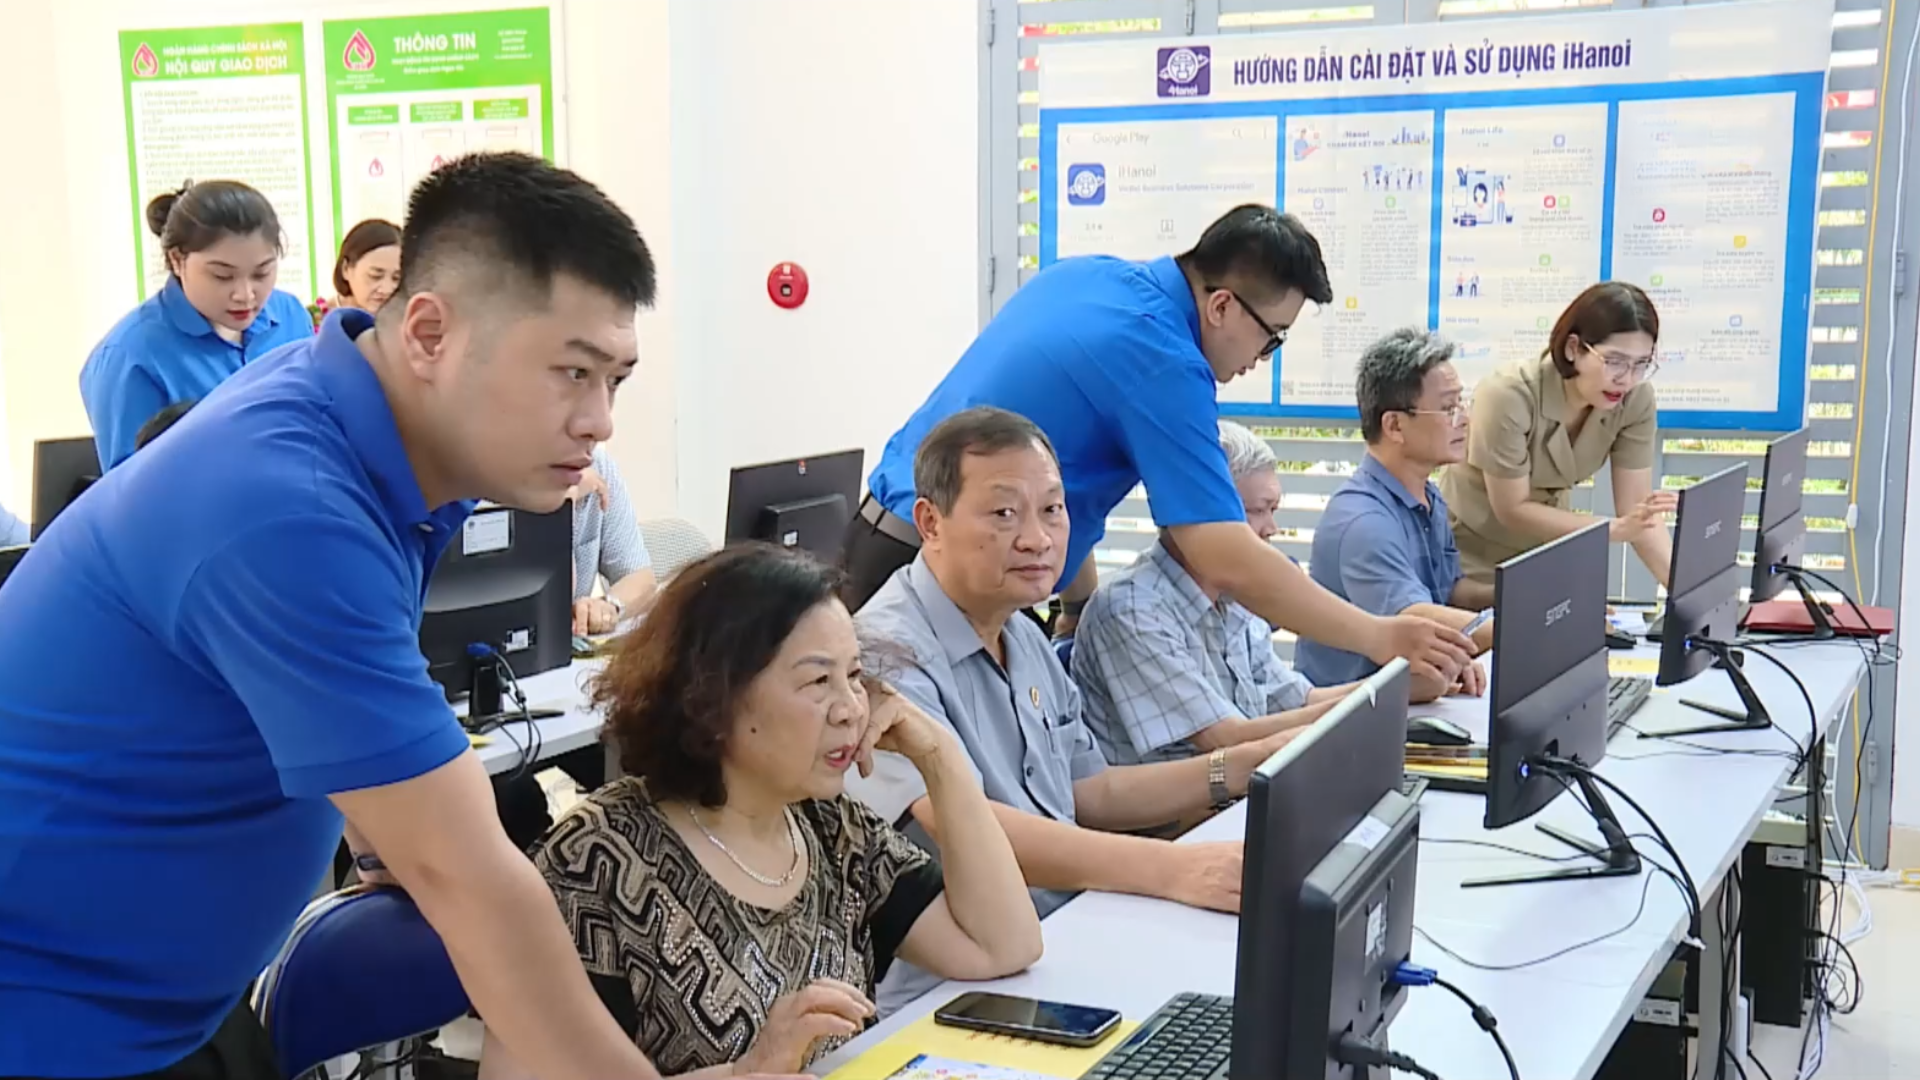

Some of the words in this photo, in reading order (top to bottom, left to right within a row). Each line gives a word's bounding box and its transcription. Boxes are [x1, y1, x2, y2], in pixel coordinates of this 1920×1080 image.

[393, 30, 449, 54] THÔNG
[451, 30, 477, 51] TIN
[165, 56, 188, 79] NỘI
[190, 58, 217, 75] QUY
[220, 56, 253, 72] GIAO
[255, 55, 288, 75] DỊCH
[1234, 53, 1298, 86] HƯỚNG
[1303, 44, 1344, 83] DẪN
[1349, 47, 1383, 81] CÀI
[1388, 44, 1427, 84] ĐẶT
[1431, 42, 1458, 77] VÀ
[1464, 37, 1495, 76] SỬ
[1497, 43, 1556, 79] DỤNG
[1562, 38, 1632, 70] iHanoi
[1092, 132, 1128, 146] Google
[1129, 131, 1151, 147] Play
